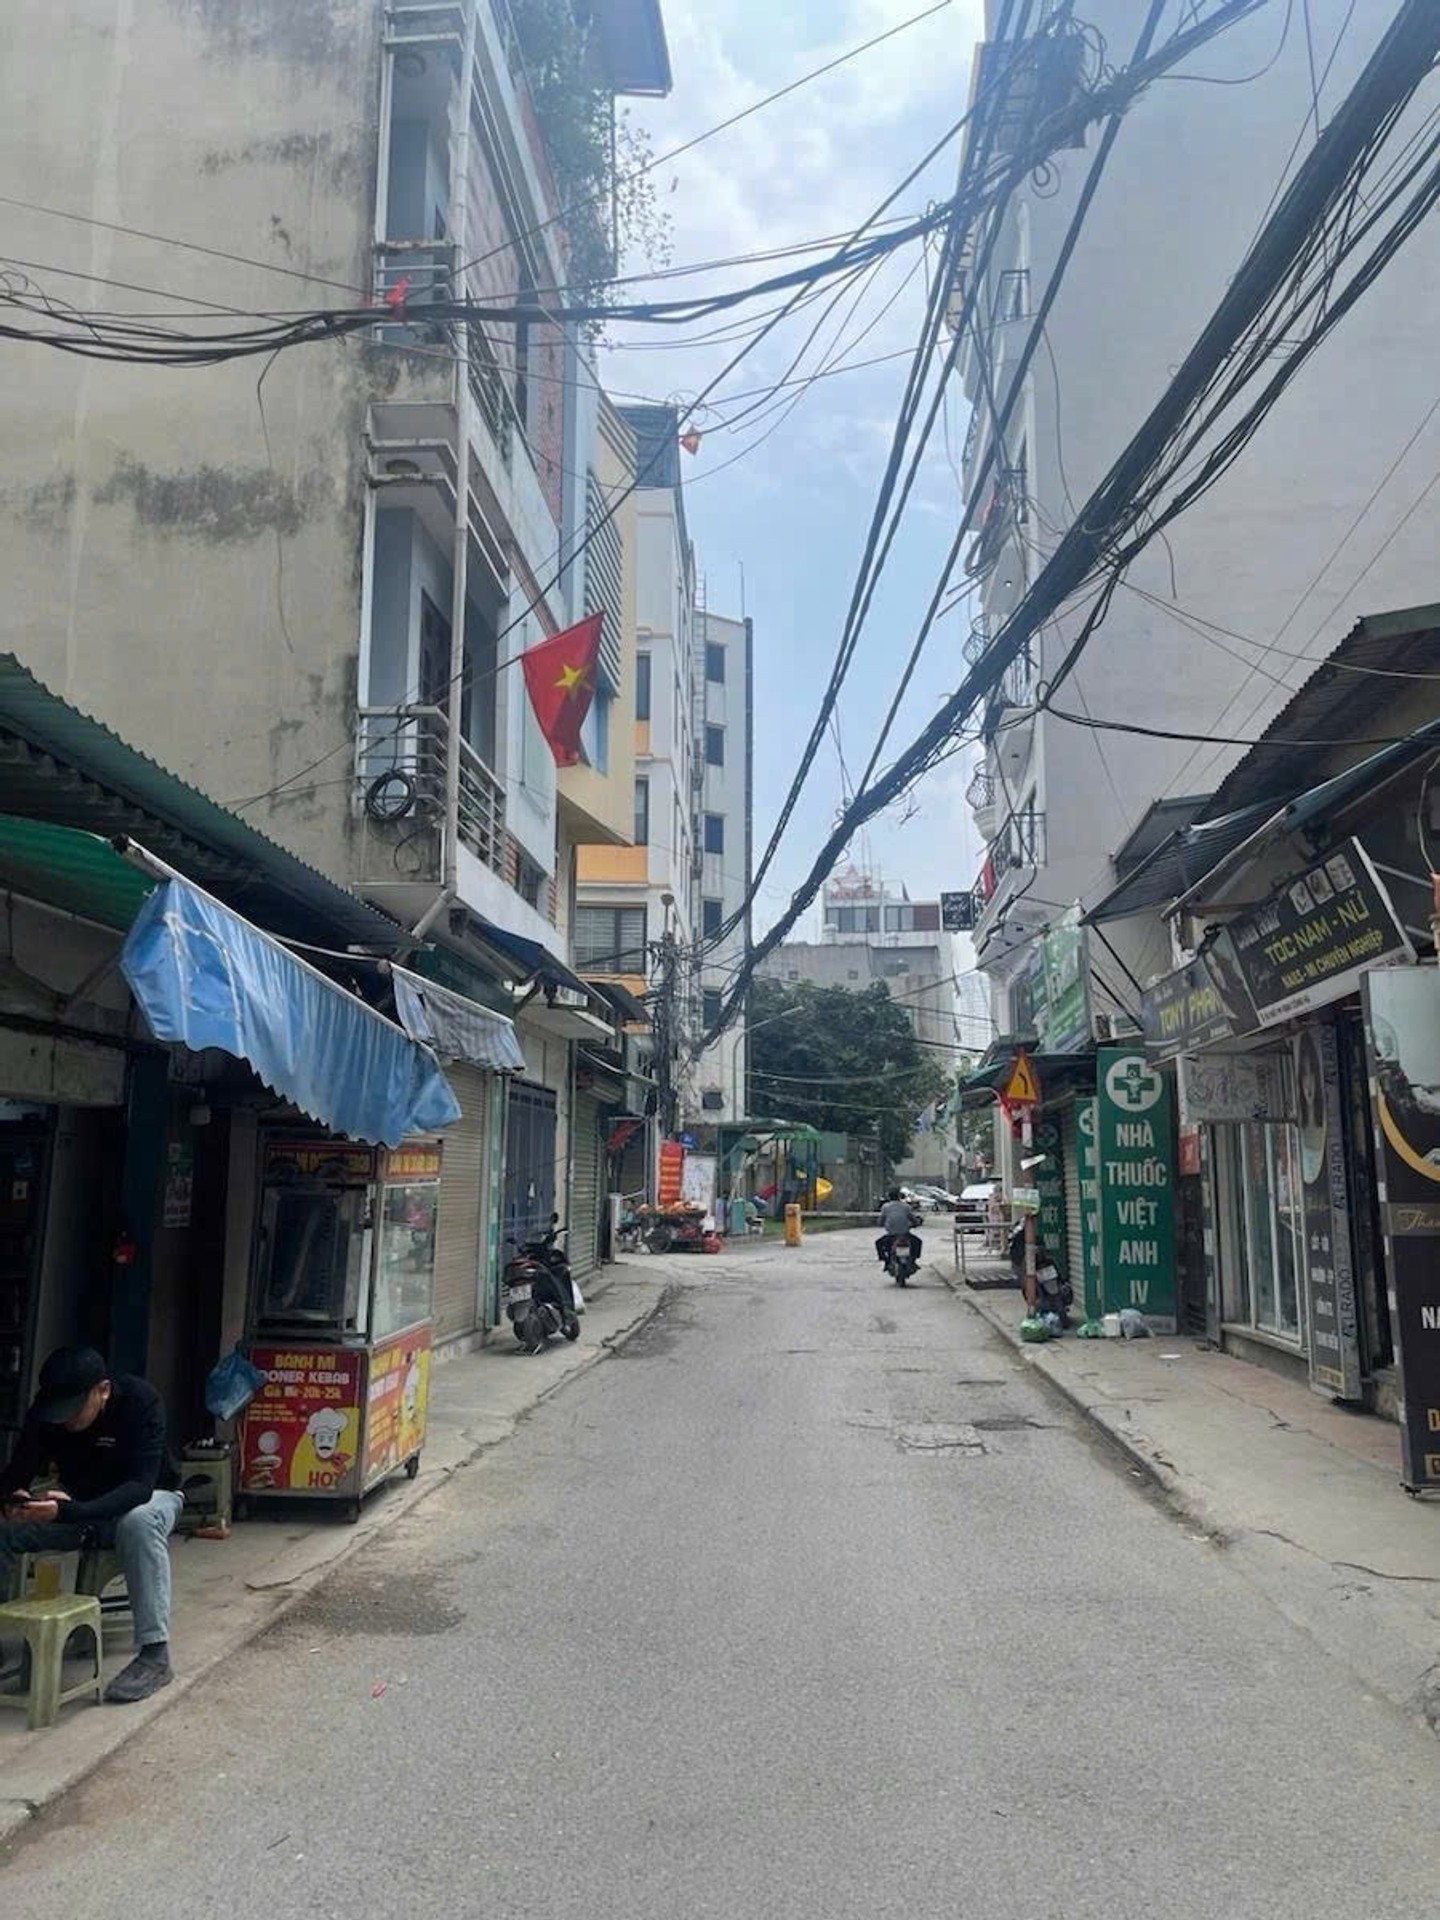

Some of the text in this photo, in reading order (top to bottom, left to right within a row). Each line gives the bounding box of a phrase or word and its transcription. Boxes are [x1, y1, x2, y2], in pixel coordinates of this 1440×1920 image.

[1264, 934, 1298, 967] TÓC
[1293, 916, 1333, 951] NAM
[1116, 1120, 1154, 1148] NHÀ
[1105, 1157, 1168, 1187] THUỐC
[1116, 1196, 1159, 1230] VIỆT
[1118, 1239, 1159, 1265] ANH
[1129, 1279, 1149, 1305] IV
[308, 1371, 350, 1385] KEBAB
